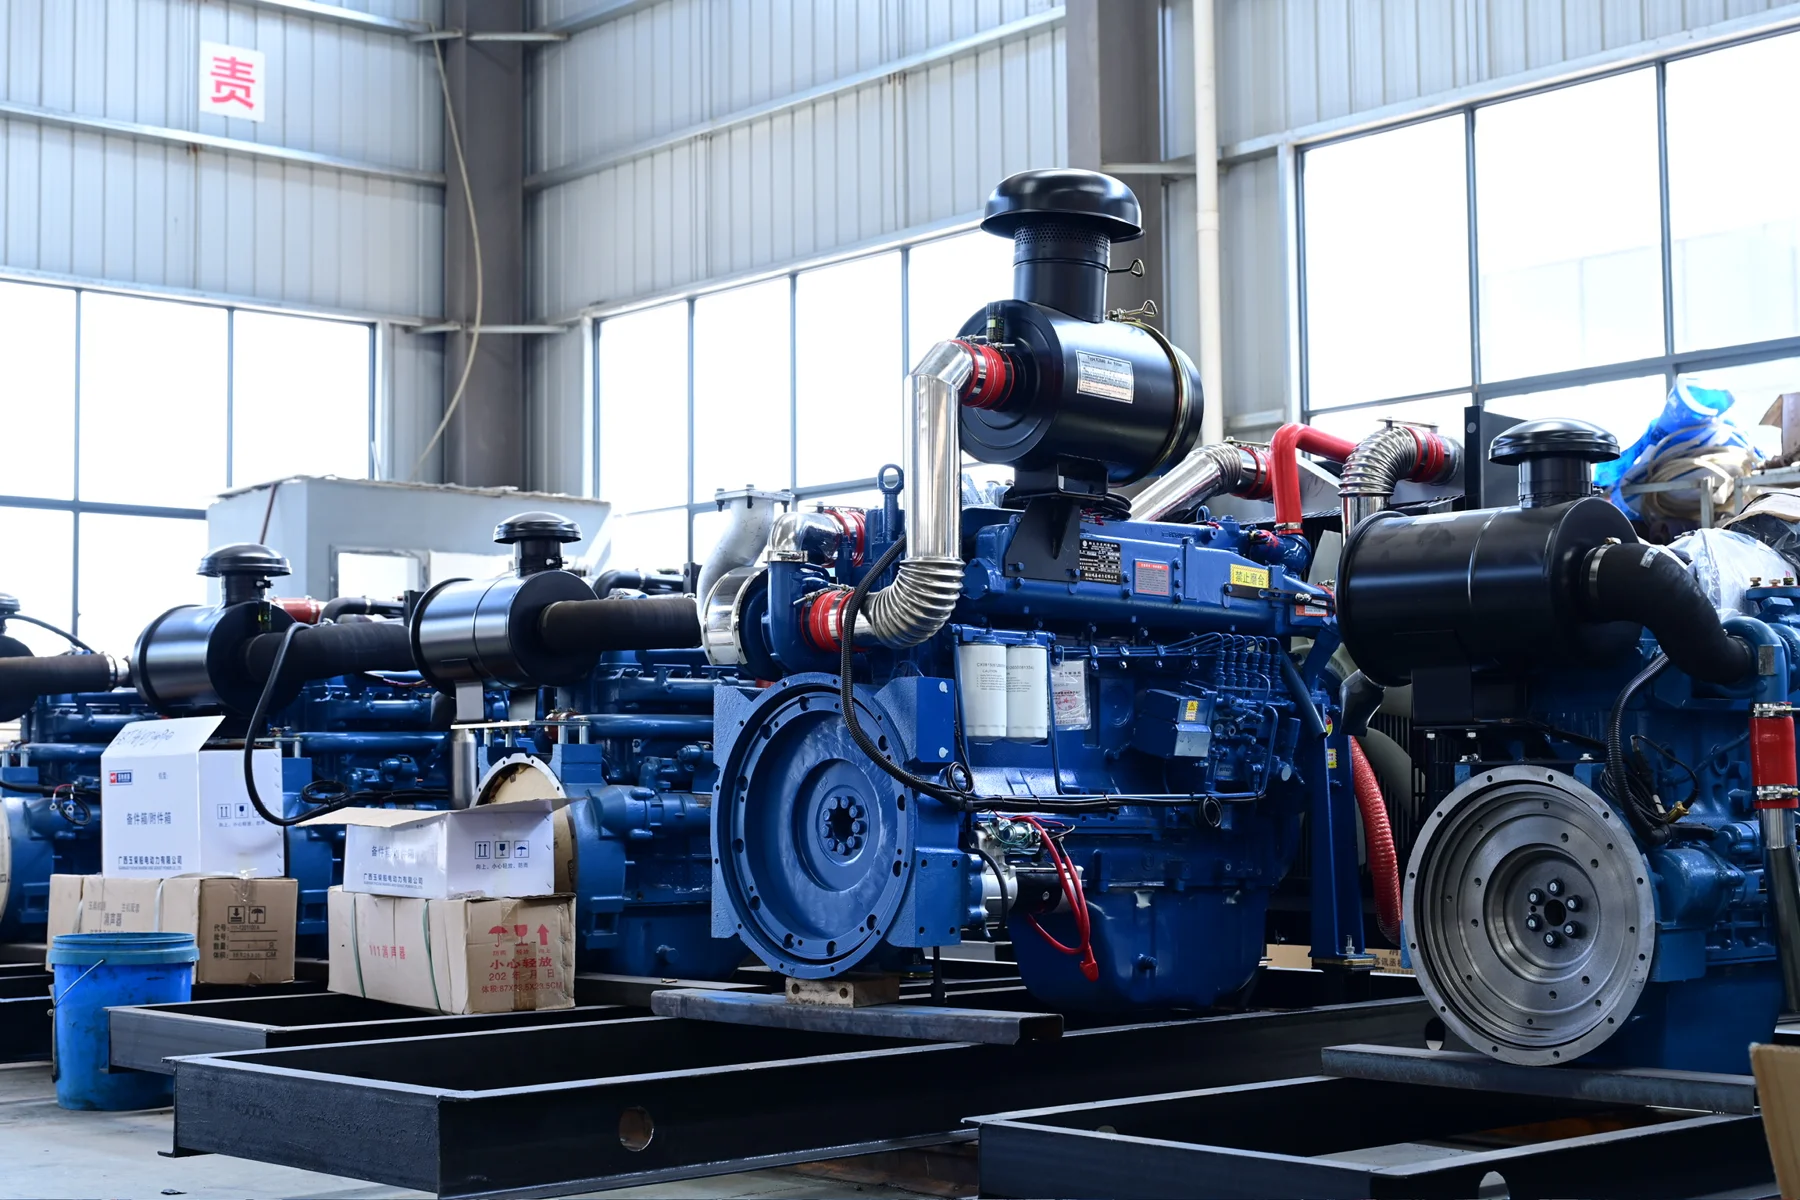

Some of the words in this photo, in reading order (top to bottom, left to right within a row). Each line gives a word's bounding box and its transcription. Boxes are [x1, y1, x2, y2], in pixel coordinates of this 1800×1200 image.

[210, 56, 255, 110] 责
[490, 957, 552, 970] 小心轻放
[488, 972, 507, 981] 202
[547, 968, 555, 978] 日
